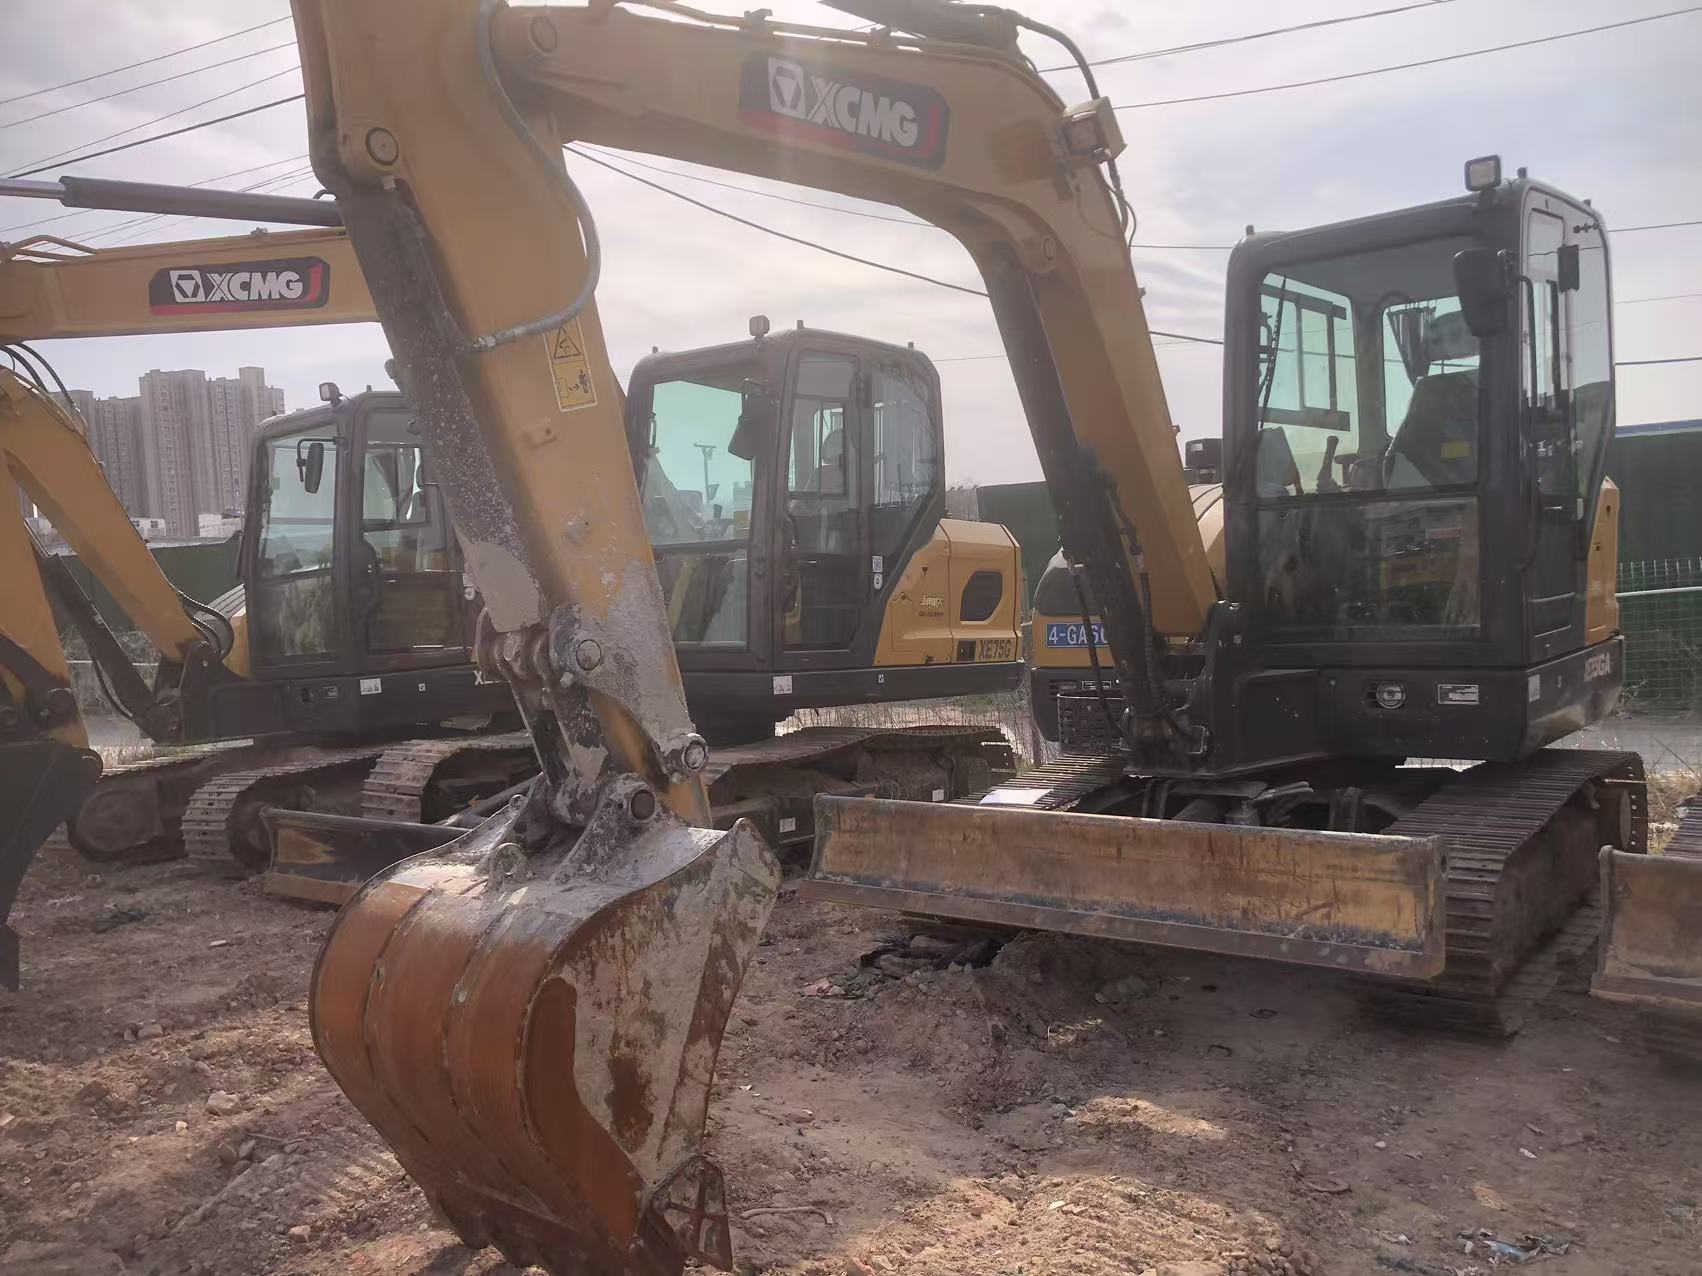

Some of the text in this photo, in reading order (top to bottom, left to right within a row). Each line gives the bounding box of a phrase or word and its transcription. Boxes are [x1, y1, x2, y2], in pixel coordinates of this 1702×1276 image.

[806, 75, 918, 147] XCMG
[207, 271, 304, 302] XCMG
[979, 639, 1011, 660] XE75G
